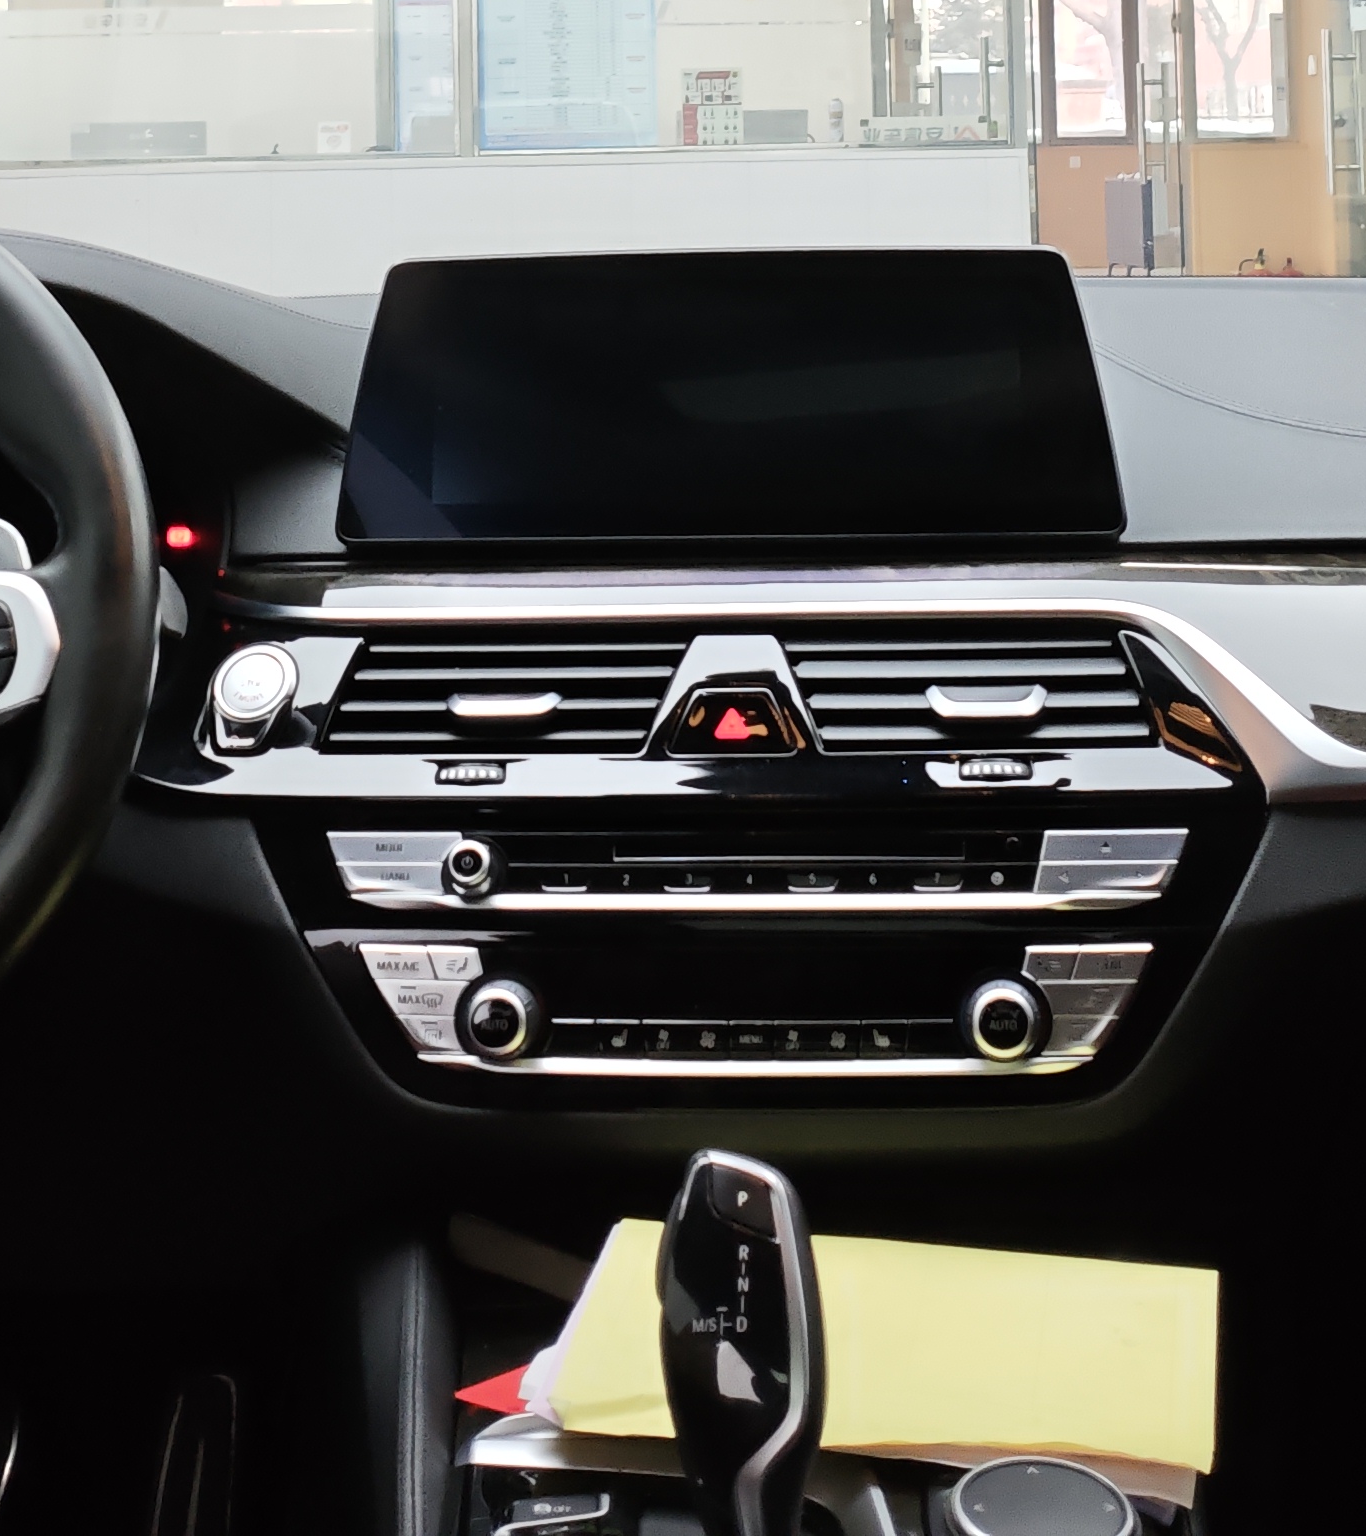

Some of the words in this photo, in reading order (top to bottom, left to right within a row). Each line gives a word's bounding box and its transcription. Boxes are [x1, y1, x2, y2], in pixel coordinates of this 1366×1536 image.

[376, 961, 401, 971] MAX
[397, 994, 422, 1005] MAX
[481, 1022, 509, 1031] AUTO
[989, 1019, 1018, 1032] AUTO
[739, 1034, 764, 1045] MENU
[737, 1190, 749, 1207] P
[738, 1244, 750, 1261] R
[737, 1277, 750, 1293] N
[691, 1317, 717, 1333] M/S
[736, 1315, 748, 1333] D
